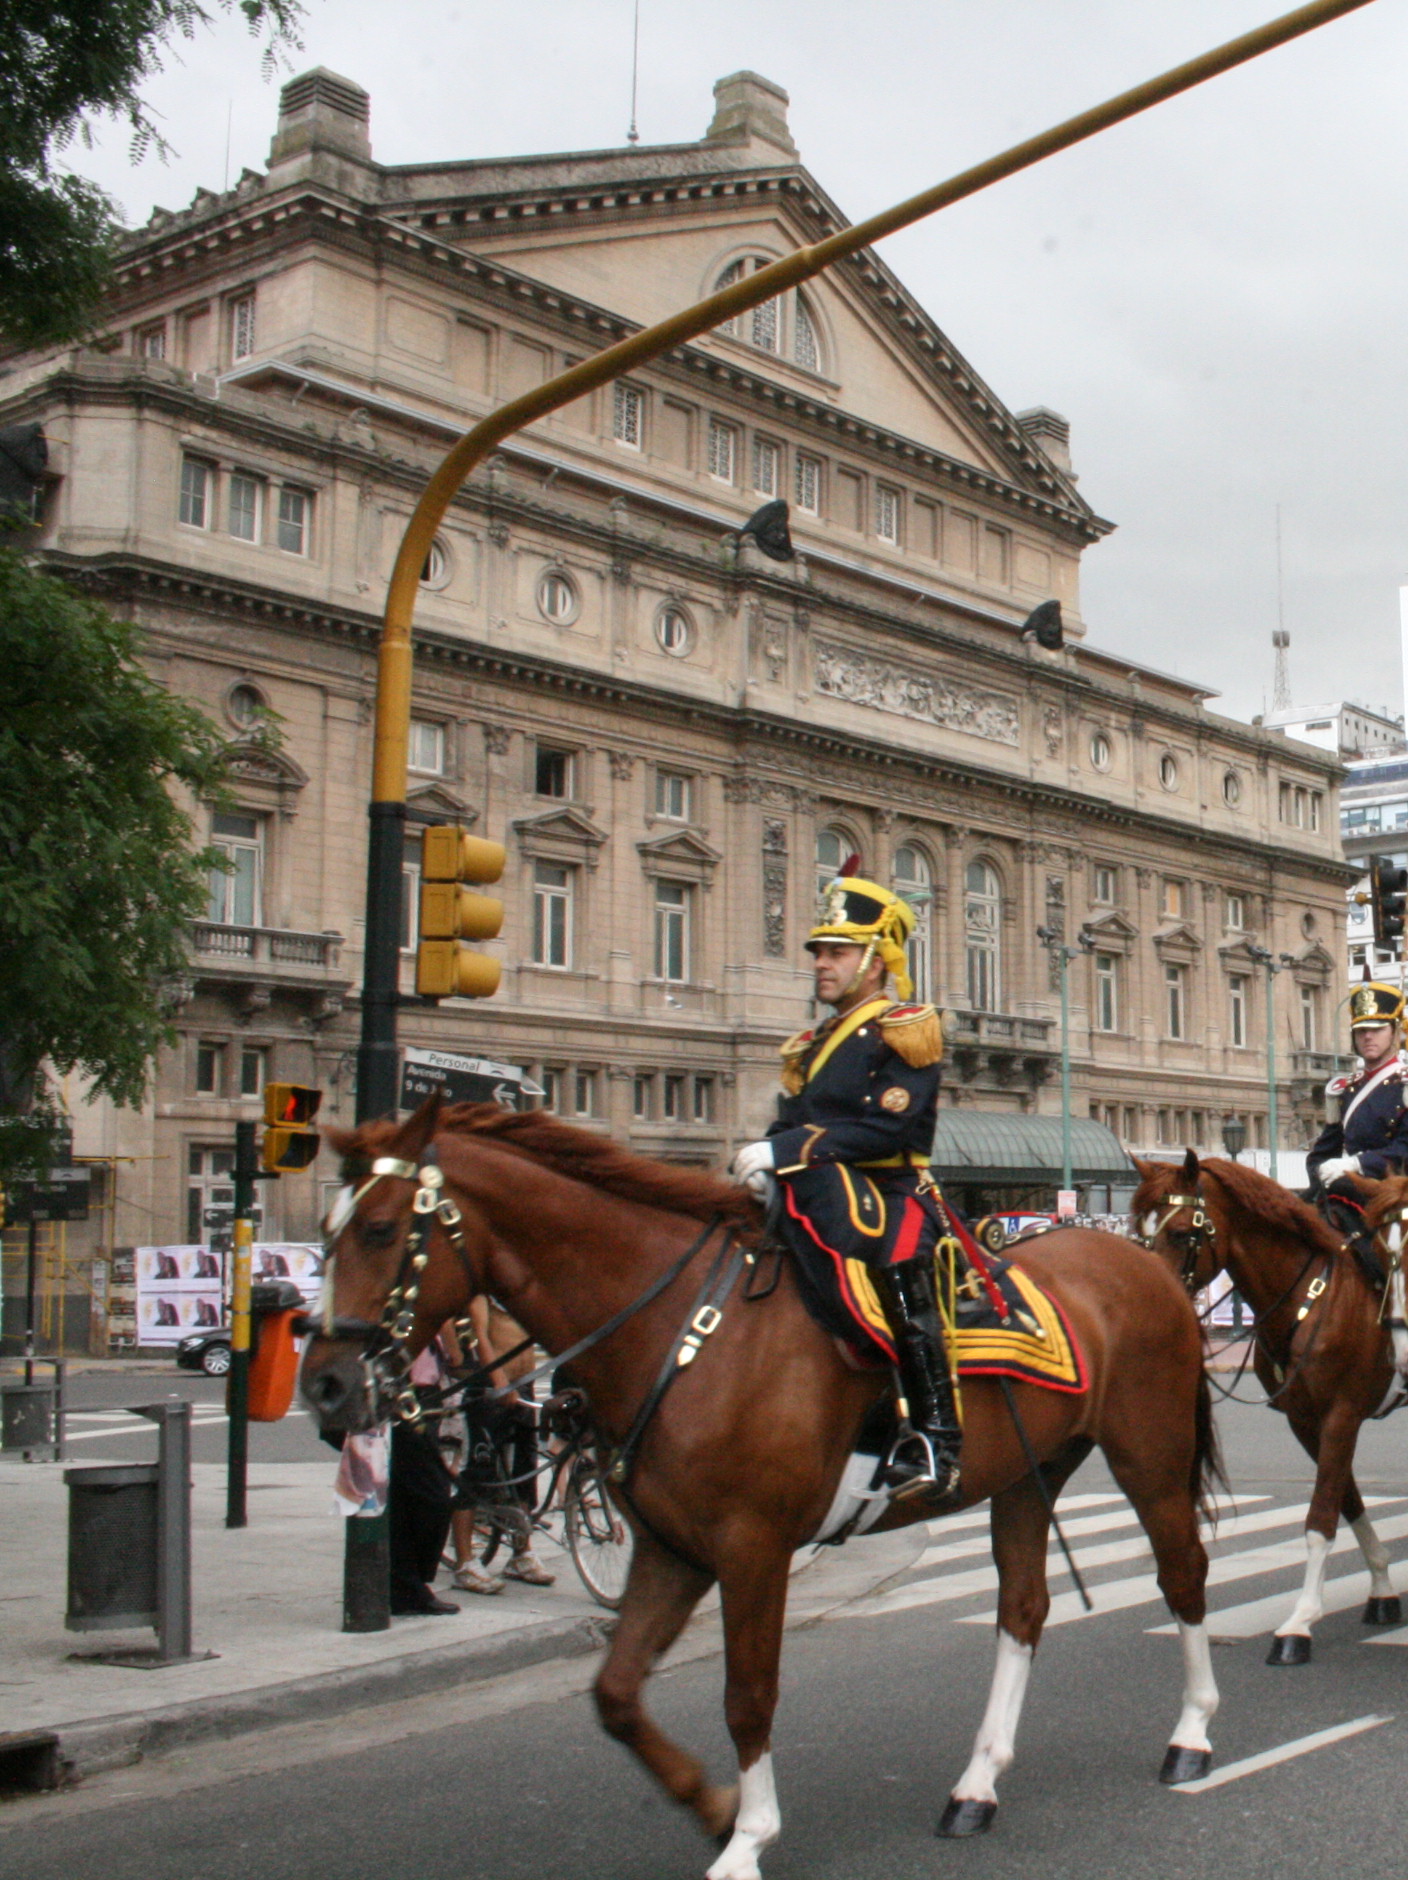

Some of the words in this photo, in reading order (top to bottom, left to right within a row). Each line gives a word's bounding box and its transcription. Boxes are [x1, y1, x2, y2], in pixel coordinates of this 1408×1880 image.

[428, 1053, 481, 1072] Personal
[406, 1064, 447, 1081] Avenida
[405, 1079, 413, 1091] 9
[414, 1081, 428, 1094] de
